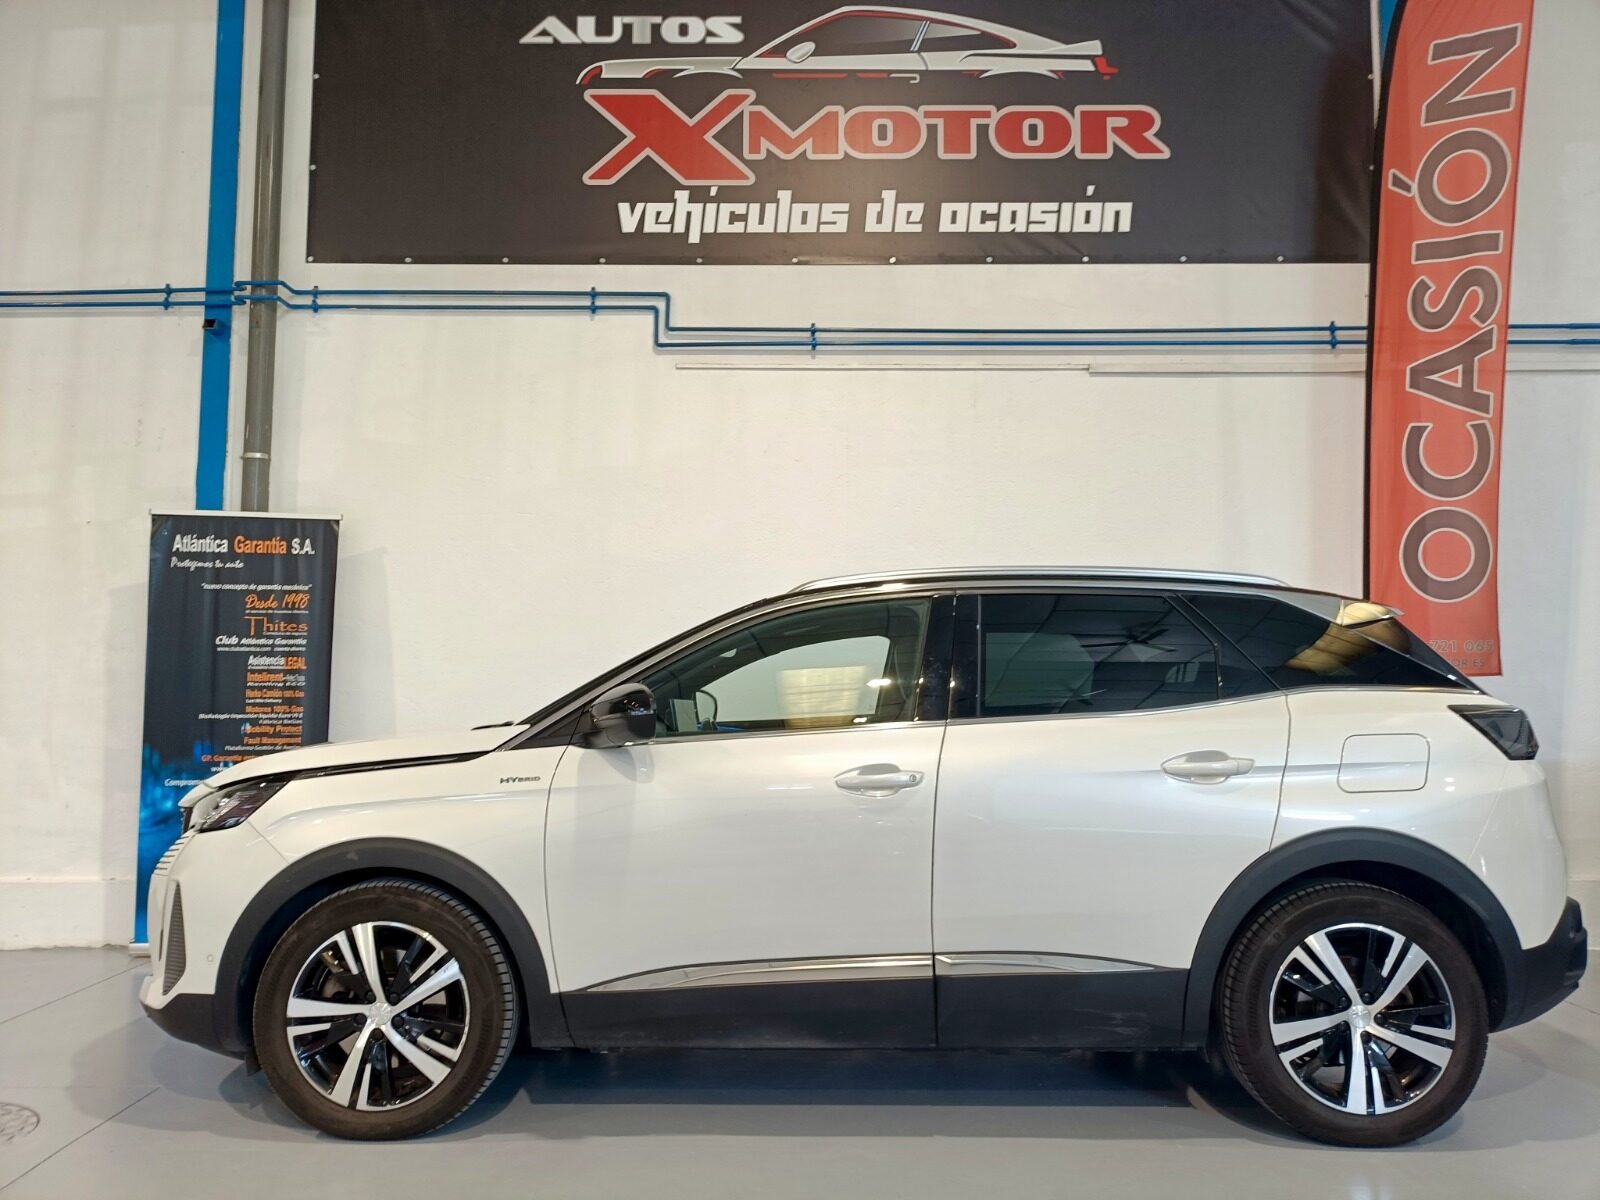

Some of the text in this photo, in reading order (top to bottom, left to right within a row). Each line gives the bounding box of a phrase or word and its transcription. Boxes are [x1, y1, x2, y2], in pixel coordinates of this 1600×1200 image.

[519, 16, 744, 45] AUTOS
[617, 185, 1134, 244] vehículos de ocasión
[1387, 22, 1523, 604] OCASIÓN
[172, 533, 316, 555] Atlántica Garantía S.A.
[245, 592, 310, 609] Desde 1998
[215, 635, 240, 646] Club
[500, 776, 541, 784] HYBRID
